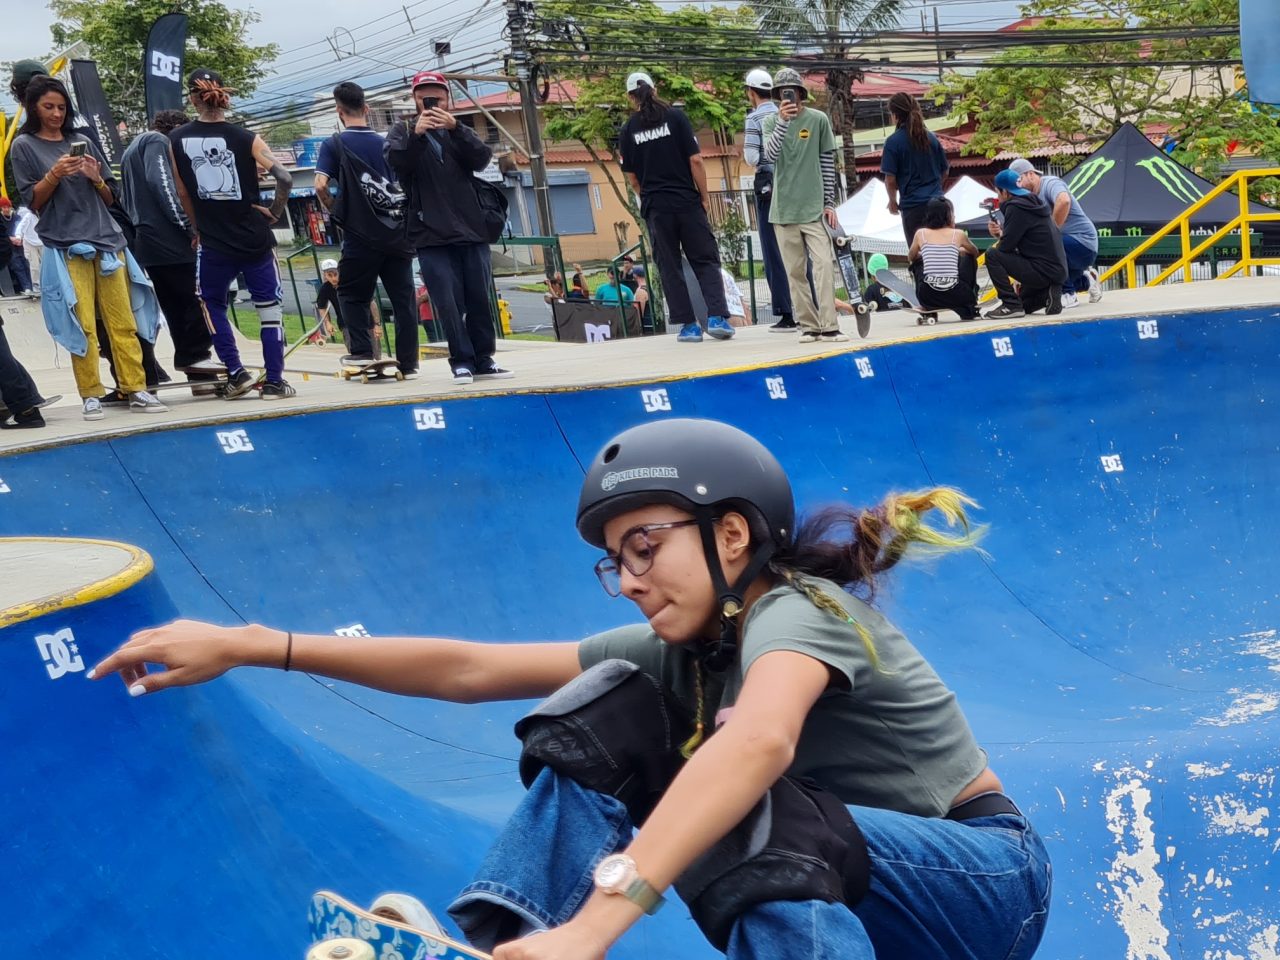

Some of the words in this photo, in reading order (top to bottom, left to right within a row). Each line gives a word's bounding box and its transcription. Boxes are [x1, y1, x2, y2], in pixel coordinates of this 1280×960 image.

[152, 50, 181, 82] DC
[634, 122, 671, 145] PANAMÁ
[618, 468, 650, 482] KILLER
[650, 467, 679, 479] PADS
[35, 627, 86, 679] DC
